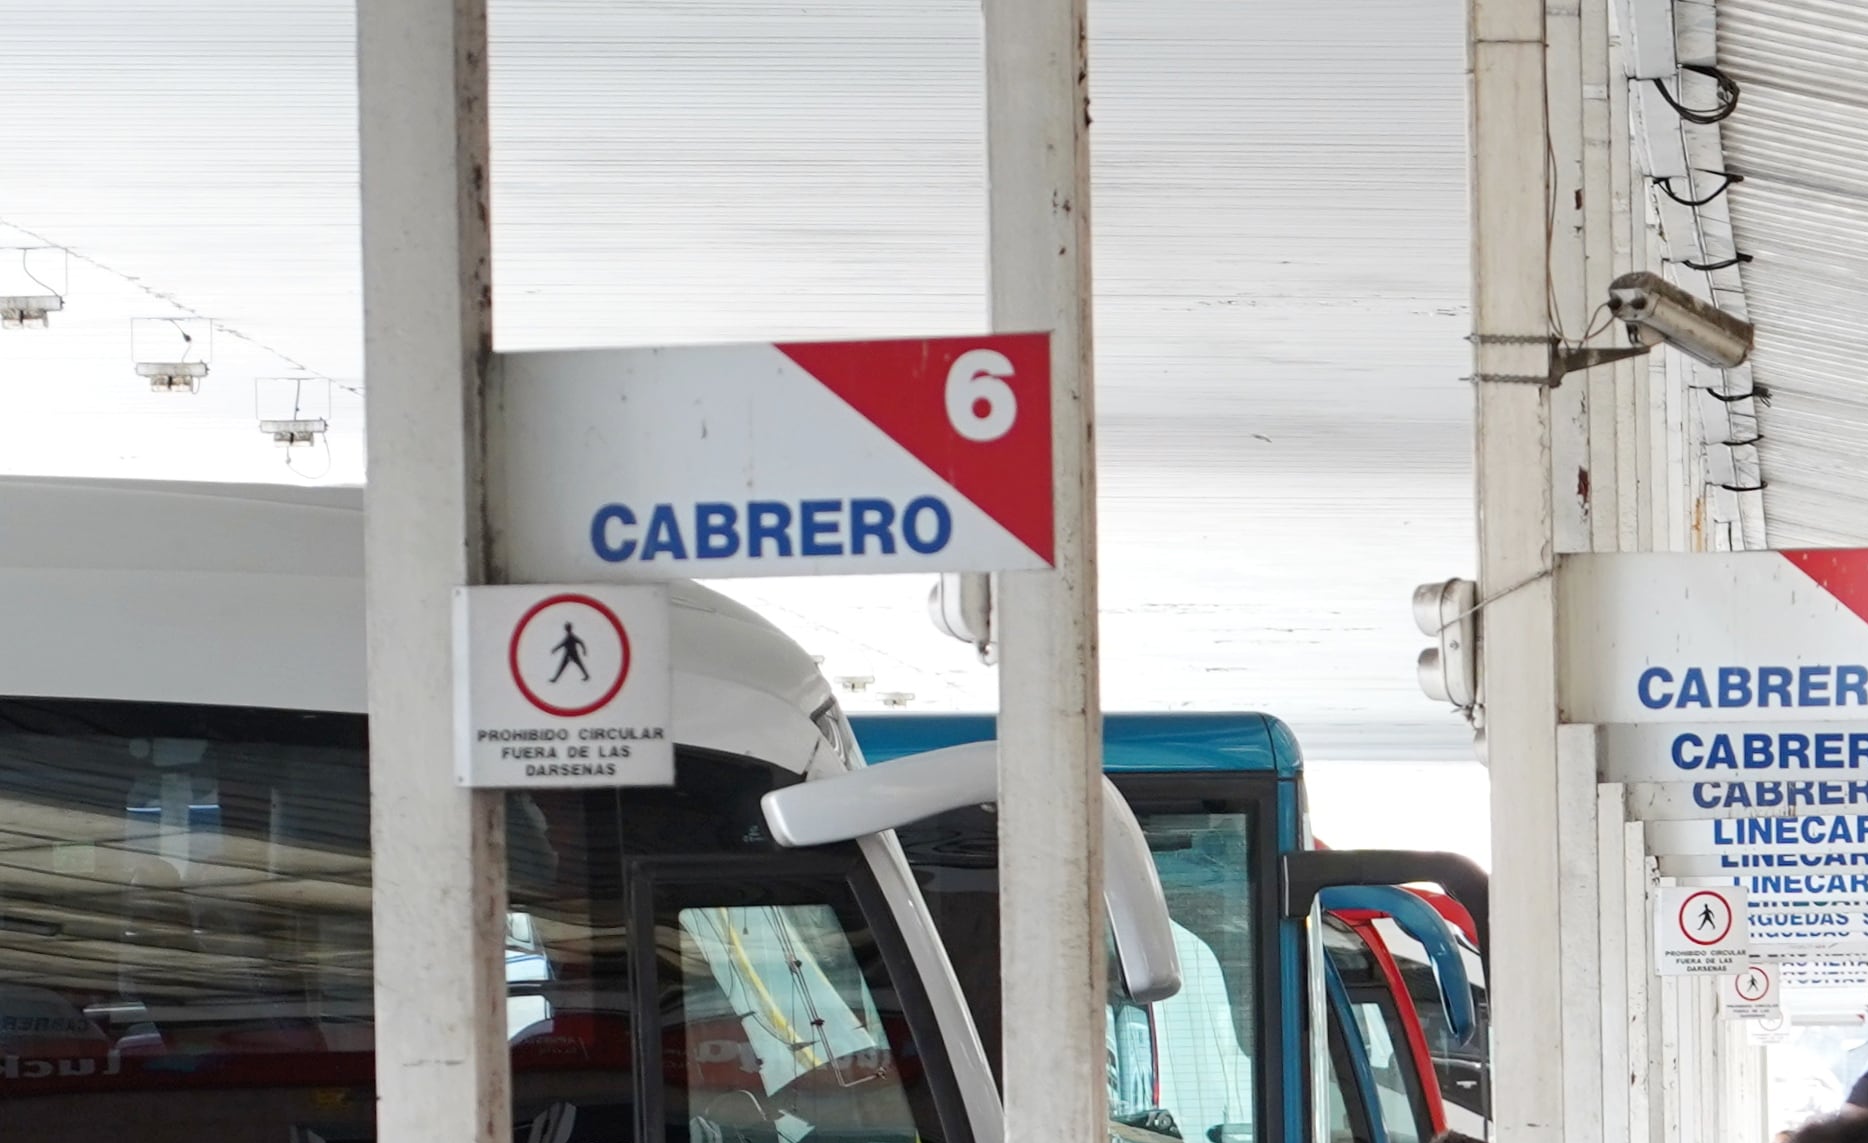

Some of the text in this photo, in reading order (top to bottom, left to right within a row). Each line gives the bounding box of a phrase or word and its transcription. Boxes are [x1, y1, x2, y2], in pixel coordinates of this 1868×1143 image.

[945, 349, 1016, 441] 6
[590, 496, 952, 562] CABRERO
[477, 727, 665, 742] PROHIBIDO CIRCULAR
[502, 745, 631, 759] FUERA DE LAS
[526, 763, 616, 777] DARSENAS
